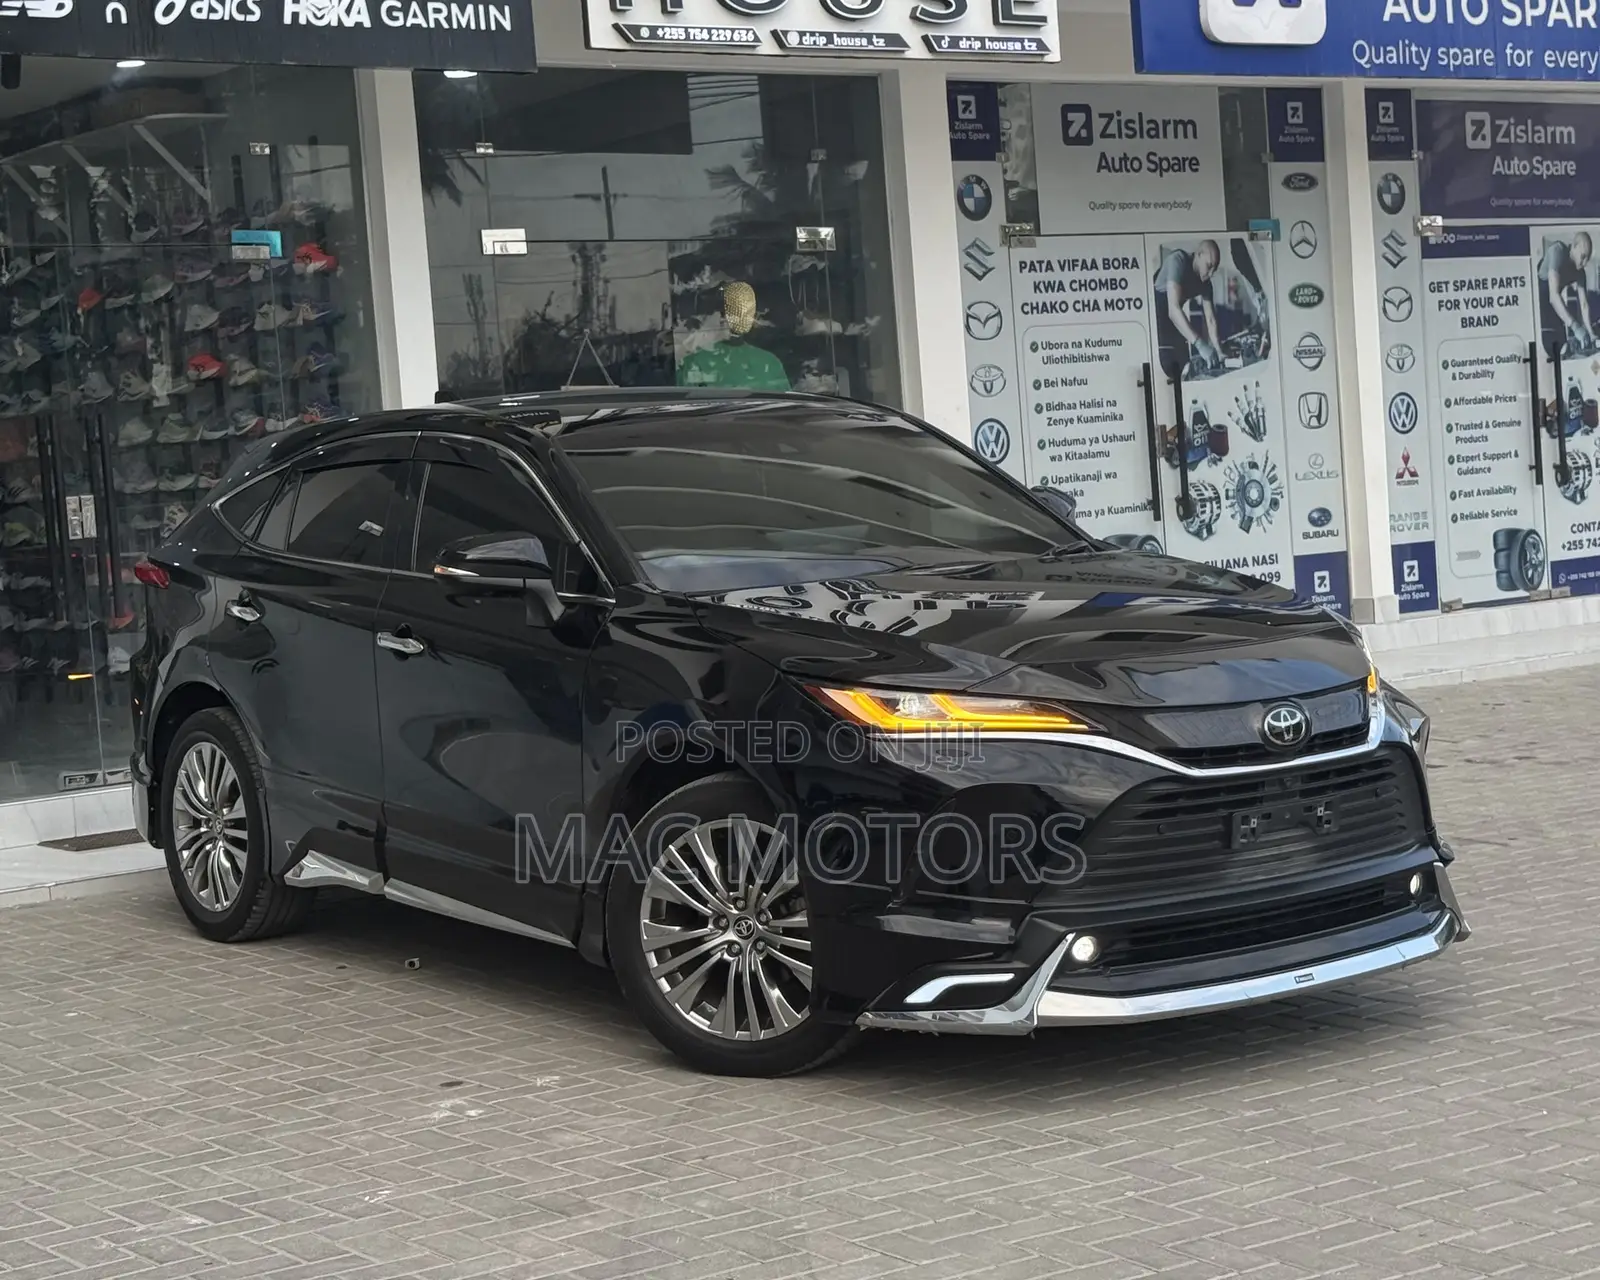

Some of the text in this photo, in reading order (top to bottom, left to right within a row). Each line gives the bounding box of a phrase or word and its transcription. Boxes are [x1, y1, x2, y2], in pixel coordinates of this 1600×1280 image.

[283, 0, 372, 28] HOKA
[380, 0, 512, 31] GARMIN
[1382, 0, 1489, 25] AUTO
[656, 27, 755, 42] +255 754 229 636
[958, 37, 1038, 51] drip house tz
[1352, 39, 1431, 71] Quality
[1437, 46, 1494, 71] spare
[1505, 42, 1534, 68] for
[1098, 110, 1198, 139] Zislarm
[1495, 117, 1576, 144] Zislarm
[1097, 151, 1200, 178] Auto Spare
[1492, 155, 1577, 179] Auto Spare
[1088, 200, 1117, 211] Quality
[1141, 200, 1152, 209] for
[1153, 200, 1192, 211] everybody
[1019, 256, 1140, 274] PATA VIFAA BORA
[1033, 277, 1129, 294] KWA CHOMBO
[1428, 275, 1526, 294] GET SPARE PARTS
[1020, 297, 1143, 315] CHAKO CHA MOTO
[1437, 294, 1520, 312] FOR YOUR CAR
[1460, 314, 1499, 329] BRAND
[1041, 338, 1123, 351] Ubora na Kudumu
[1041, 352, 1110, 365] Uliothibitishwa
[1295, 348, 1323, 357] NISSAN
[1450, 353, 1522, 369] Guaranteed Quality
[1043, 376, 1088, 388] Bei Nafuu
[1458, 369, 1495, 381] Durability
[1045, 398, 1117, 412] Bidhaa Halisi na
[1453, 393, 1517, 407] Affordable Prices
[1046, 411, 1124, 427] Zenye Kuaminika
[1455, 418, 1522, 432] Trusted & Genuine
[1048, 431, 1136, 448] Huduma ya Ushauri
[1455, 434, 1489, 445] Products
[1049, 449, 1110, 463] wa Kitaalamu
[1456, 449, 1520, 465] Expert Support &
[1050, 470, 1118, 486] Upatikanaji wa
[1456, 465, 1492, 476] Guidance
[1458, 485, 1517, 499] Fast Availability
[1094, 509, 1106, 520] ya
[1459, 507, 1518, 521] Reliable Service
[1302, 529, 1339, 540] SUBARU
[1561, 539, 1584, 552] +255
[1252, 553, 1279, 568] NASI
